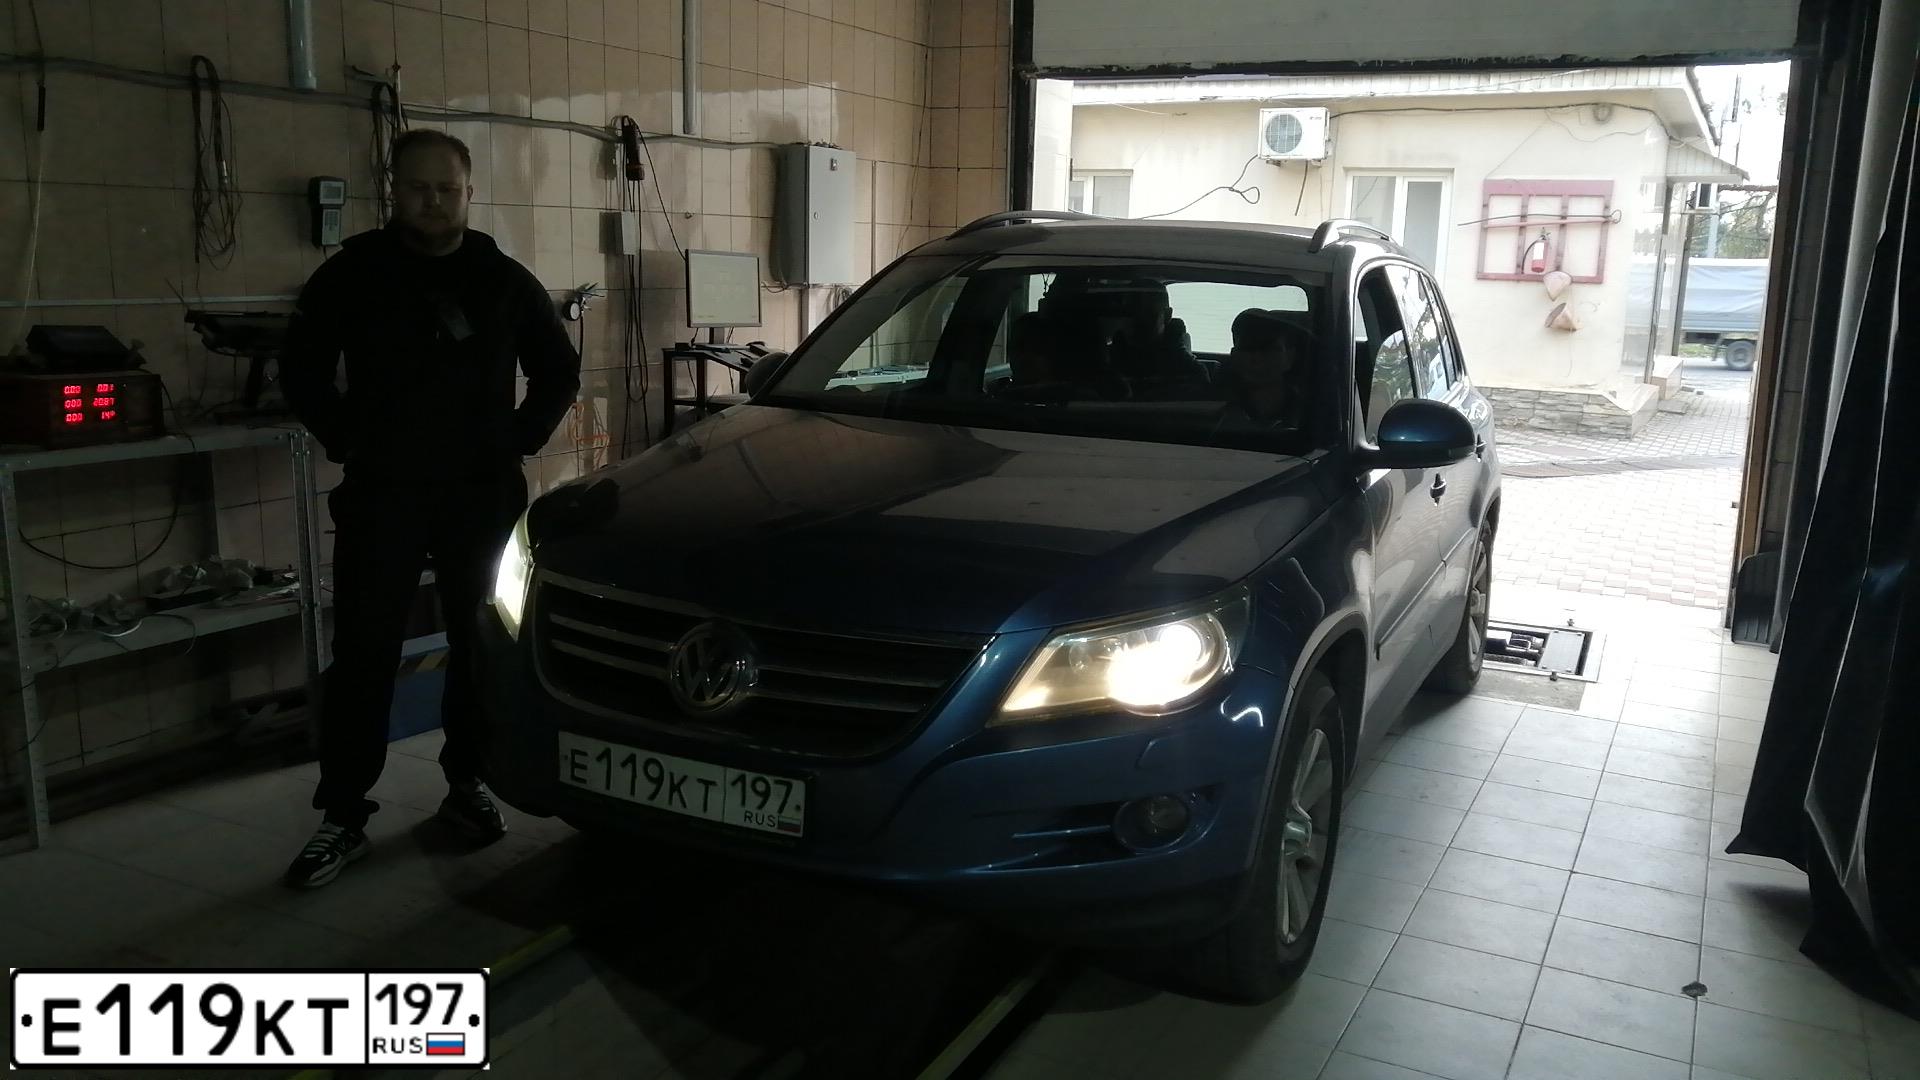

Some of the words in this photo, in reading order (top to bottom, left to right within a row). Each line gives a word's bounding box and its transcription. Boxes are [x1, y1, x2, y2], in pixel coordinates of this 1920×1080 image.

[570, 748, 717, 814] E119KT
[731, 773, 794, 814] 197
[743, 811, 776, 828] RUS
